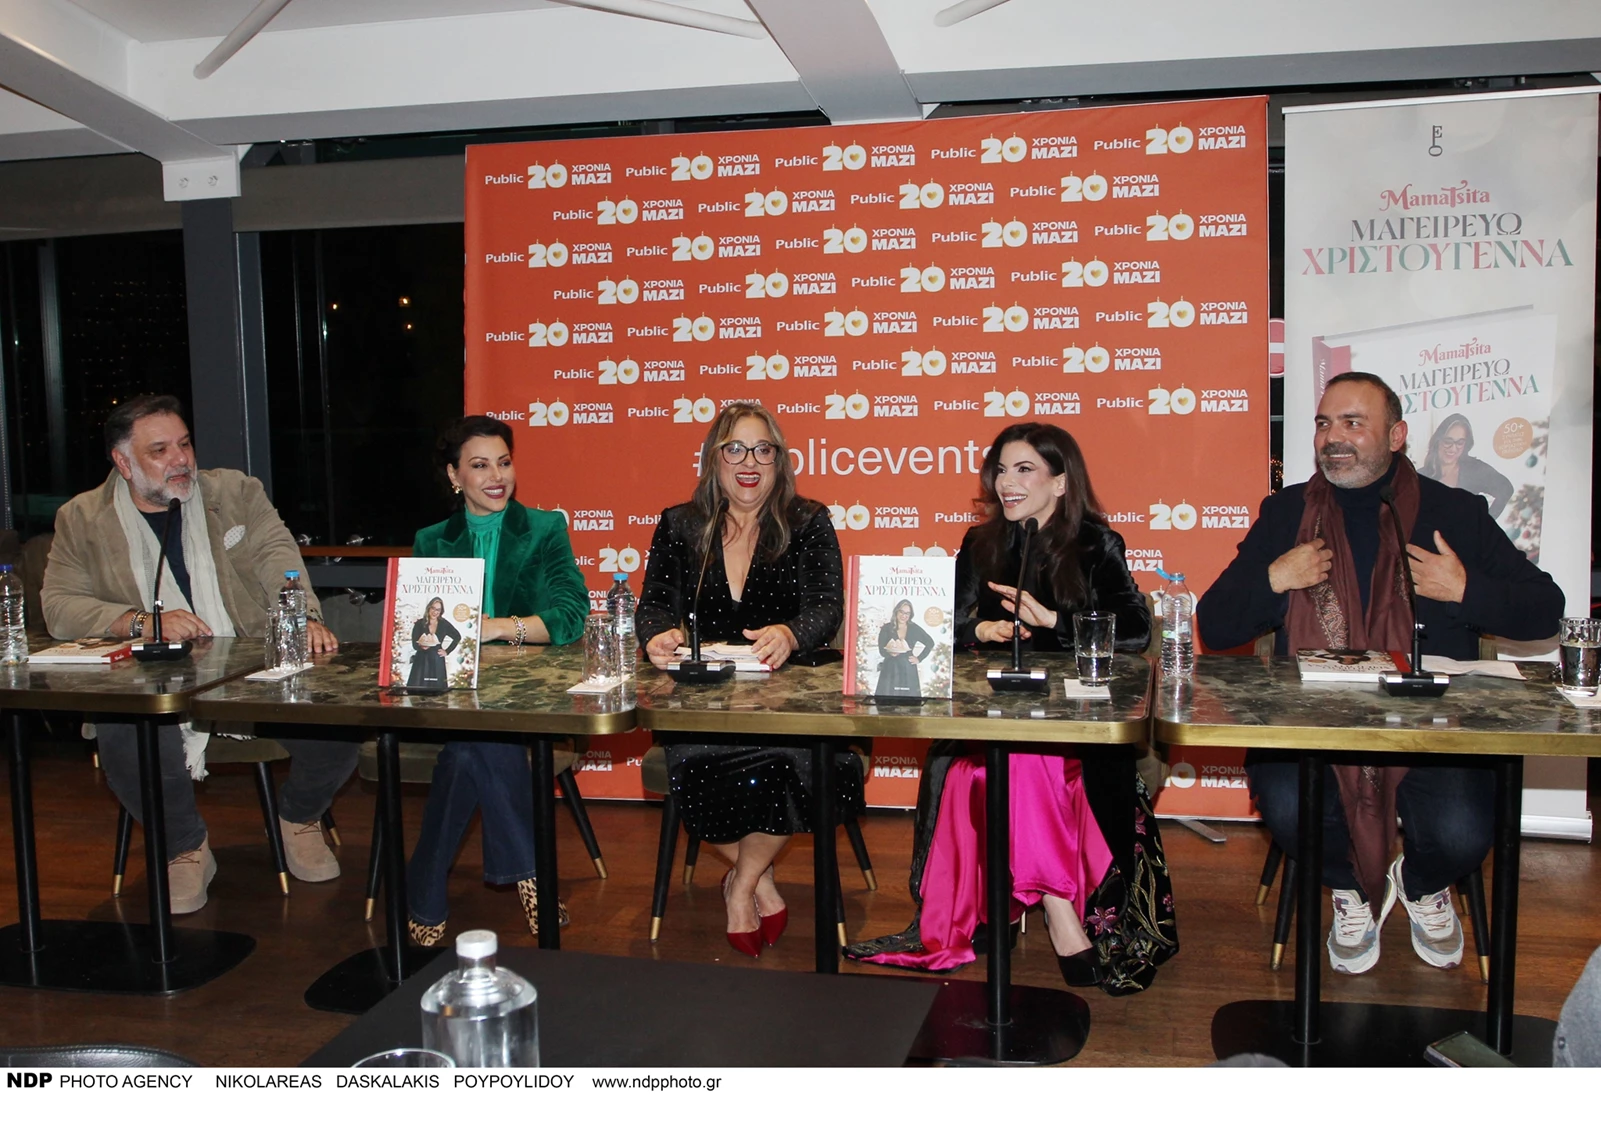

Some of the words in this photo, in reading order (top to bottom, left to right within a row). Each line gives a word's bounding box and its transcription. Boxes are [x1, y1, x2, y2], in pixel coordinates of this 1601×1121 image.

[1199, 125, 1246, 137] ΧΡΟΝΙΑ
[1033, 136, 1078, 146] ΧΡΟΝΙΑ
[1094, 138, 1140, 150] Public
[1145, 124, 1194, 155] 20
[1198, 135, 1246, 151] ΜΑΖΙ
[872, 144, 915, 154] ΧΡΟΝΙΑ
[931, 147, 975, 159] Public
[980, 134, 1028, 164] 20
[1031, 145, 1078, 160] ΜΑΖΙ
[718, 154, 760, 164] ΧΡΟΝΙΑ
[775, 155, 818, 168] Public
[822, 143, 867, 171] 20
[870, 154, 916, 168] ΜΑΖΙ
[572, 163, 611, 173] ΧΡΟΝΙΑ
[626, 166, 665, 177] Public
[671, 154, 714, 181] 20
[717, 163, 760, 177] ΜΑΖΙ
[485, 173, 523, 185] Public
[528, 162, 568, 189] 20
[571, 172, 612, 186] ΜΑΖΙ
[1113, 174, 1159, 185] ΧΡΟΝΙΑ
[950, 182, 994, 192] ΧΡΟΝΙΑ
[1010, 185, 1056, 197] Public
[1061, 172, 1108, 202] 20
[1112, 184, 1160, 199] ΜΑΖΙ
[793, 189, 835, 200] ΧΡΟΝΙΑ
[850, 193, 894, 204] Public
[899, 180, 945, 210] 20
[948, 192, 994, 206] ΜΑΖΙ
[1379, 180, 1490, 211] MamaTsita
[643, 199, 684, 209] ΧΡΟΝΙΑ
[698, 201, 739, 213] Public
[744, 189, 788, 217] 20
[792, 198, 836, 213] ΜΑΖΙ
[553, 210, 592, 220] Public
[597, 198, 638, 225] 20
[642, 208, 684, 222] ΜΑΖΙ
[1200, 213, 1247, 224] ΧΡΟΝΙΑ
[872, 228, 916, 237] ΧΡΟΝΙΑ
[932, 231, 976, 243] Public
[981, 218, 1028, 248] 20
[1033, 221, 1078, 231] ΧΡΟΝΙΑ
[1094, 224, 1141, 236] Public
[1146, 212, 1195, 241] 20
[1198, 223, 1248, 238] ΜΑΖΙ
[1351, 212, 1522, 242] ΜΑΓΕΙΡΕΥΩ
[719, 235, 761, 245] ΧΡΟΝΙΑ
[775, 238, 818, 249] Public
[823, 226, 868, 254] 20
[871, 237, 917, 251] ΜΑΖΙ
[1032, 230, 1079, 245] ΜΑΖΙ
[573, 242, 612, 252] ΧΡΟΝΙΑ
[626, 246, 666, 257] Public
[672, 234, 714, 261] 20
[718, 244, 761, 258] ΜΑΖΙ
[486, 252, 523, 263] Public
[528, 241, 568, 268] 20
[572, 251, 613, 265] ΜΑΖΙ
[1302, 238, 1574, 276] ΧΡΙΣΤΟΥΓΕΝΝΑ
[951, 266, 995, 276] ΧΡΟΝΙΑ
[1114, 260, 1160, 271] ΧΡΟΝΙΑ
[794, 272, 836, 282] ΧΡΟΝΙΑ
[851, 276, 895, 287] Public
[900, 264, 946, 293] 20
[1010, 270, 1057, 282] Public
[1062, 258, 1109, 288] 20
[1113, 270, 1161, 285] ΜΑΖΙ
[644, 279, 684, 289] ΧΡΟΝΙΑ
[699, 282, 740, 294] Public
[745, 270, 789, 298] 20
[792, 281, 837, 296] ΜΑΖΙ
[949, 276, 996, 290] ΜΑΖΙ
[553, 289, 592, 300] Public
[598, 278, 639, 304] 20
[642, 288, 685, 302] ΜΑΖΙ
[1034, 306, 1080, 316] ΧΡΟΝΙΑ
[1095, 310, 1142, 322] Public
[1147, 298, 1196, 328] 20
[1200, 301, 1248, 312] ΧΡΟΝΙΑ
[720, 316, 762, 326] ΧΡΟΝΙΑ
[776, 320, 819, 331] Public
[824, 309, 869, 337] 20
[874, 311, 917, 321] ΧΡΟΝΙΑ
[932, 315, 977, 327] Public
[982, 304, 1029, 332] 20
[1033, 316, 1080, 330] ΜΑΖΙ
[1199, 311, 1248, 326] ΜΑΖΙ
[486, 331, 524, 342] Public
[528, 320, 569, 347] 20
[574, 322, 613, 331] ΧΡΟΝΙΑ
[627, 326, 668, 337] Public
[673, 315, 715, 342] 20
[719, 326, 762, 339] ΜΑΖΙ
[872, 320, 918, 334] ΜΑΖΙ
[572, 331, 614, 344] ΜΑΖΙ
[952, 351, 996, 361] ΧΡΟΝΙΑ
[1012, 356, 1058, 367] Public
[1063, 343, 1110, 373] 20
[1115, 347, 1161, 357] ΧΡΟΝΙΑ
[1418, 337, 1492, 366] MamaTsita
[644, 360, 685, 369] ΧΡΟΝΙΑ
[699, 364, 740, 375] Public
[746, 352, 790, 380] 20
[794, 355, 837, 364] ΧΡΟΝΙΑ
[852, 359, 896, 371] Public
[901, 348, 947, 376] 20
[1114, 357, 1162, 371] ΜΑΖΙ
[554, 369, 593, 379] Public
[598, 358, 640, 385] 20
[793, 364, 838, 378] ΜΑΖΙ
[950, 360, 997, 374] ΜΑΖΙ
[643, 369, 685, 382] ΜΑΖΙ
[1400, 358, 1510, 392] ΜΑΓΕΙΡΕΥΩ
[874, 395, 918, 404] ΧΡΟΝΙΑ
[1035, 392, 1080, 402] ΧΡΟΝΙΑ
[1096, 396, 1144, 408] Public
[1148, 385, 1197, 415] 20
[1201, 389, 1249, 399] ΧΡΟΝΙΑ
[1398, 374, 1540, 414] ΣΤΟΥΓΕΝΝΑ
[574, 403, 613, 412] ΧΡΟΝΙΑ
[628, 407, 668, 417] Public
[673, 396, 716, 423] 20
[777, 403, 819, 414] Public
[825, 392, 870, 420] 20
[934, 400, 979, 411] Public
[984, 388, 1030, 417] 20
[1034, 402, 1081, 415] ΜΑΖΙ
[1200, 398, 1249, 413] ΜΑΖΙ
[486, 411, 524, 421] Public
[529, 400, 569, 426] 20
[572, 412, 614, 424] ΜΑΖΙ
[873, 404, 919, 418] ΜΑΖΙ
[1503, 422, 1524, 434] 50+
[875, 506, 919, 516] ΧΡΟΝΙΑ
[1149, 500, 1198, 531] 20
[1202, 505, 1250, 515] ΧΡΟΝΙΑ
[874, 516, 920, 529] ΜΑΖΙ
[1201, 515, 1250, 529] ΜΑΖΙ
[874, 756, 918, 764] ΧΡΟΝΙΑ
[874, 766, 919, 778] ΜΑΖΙ
